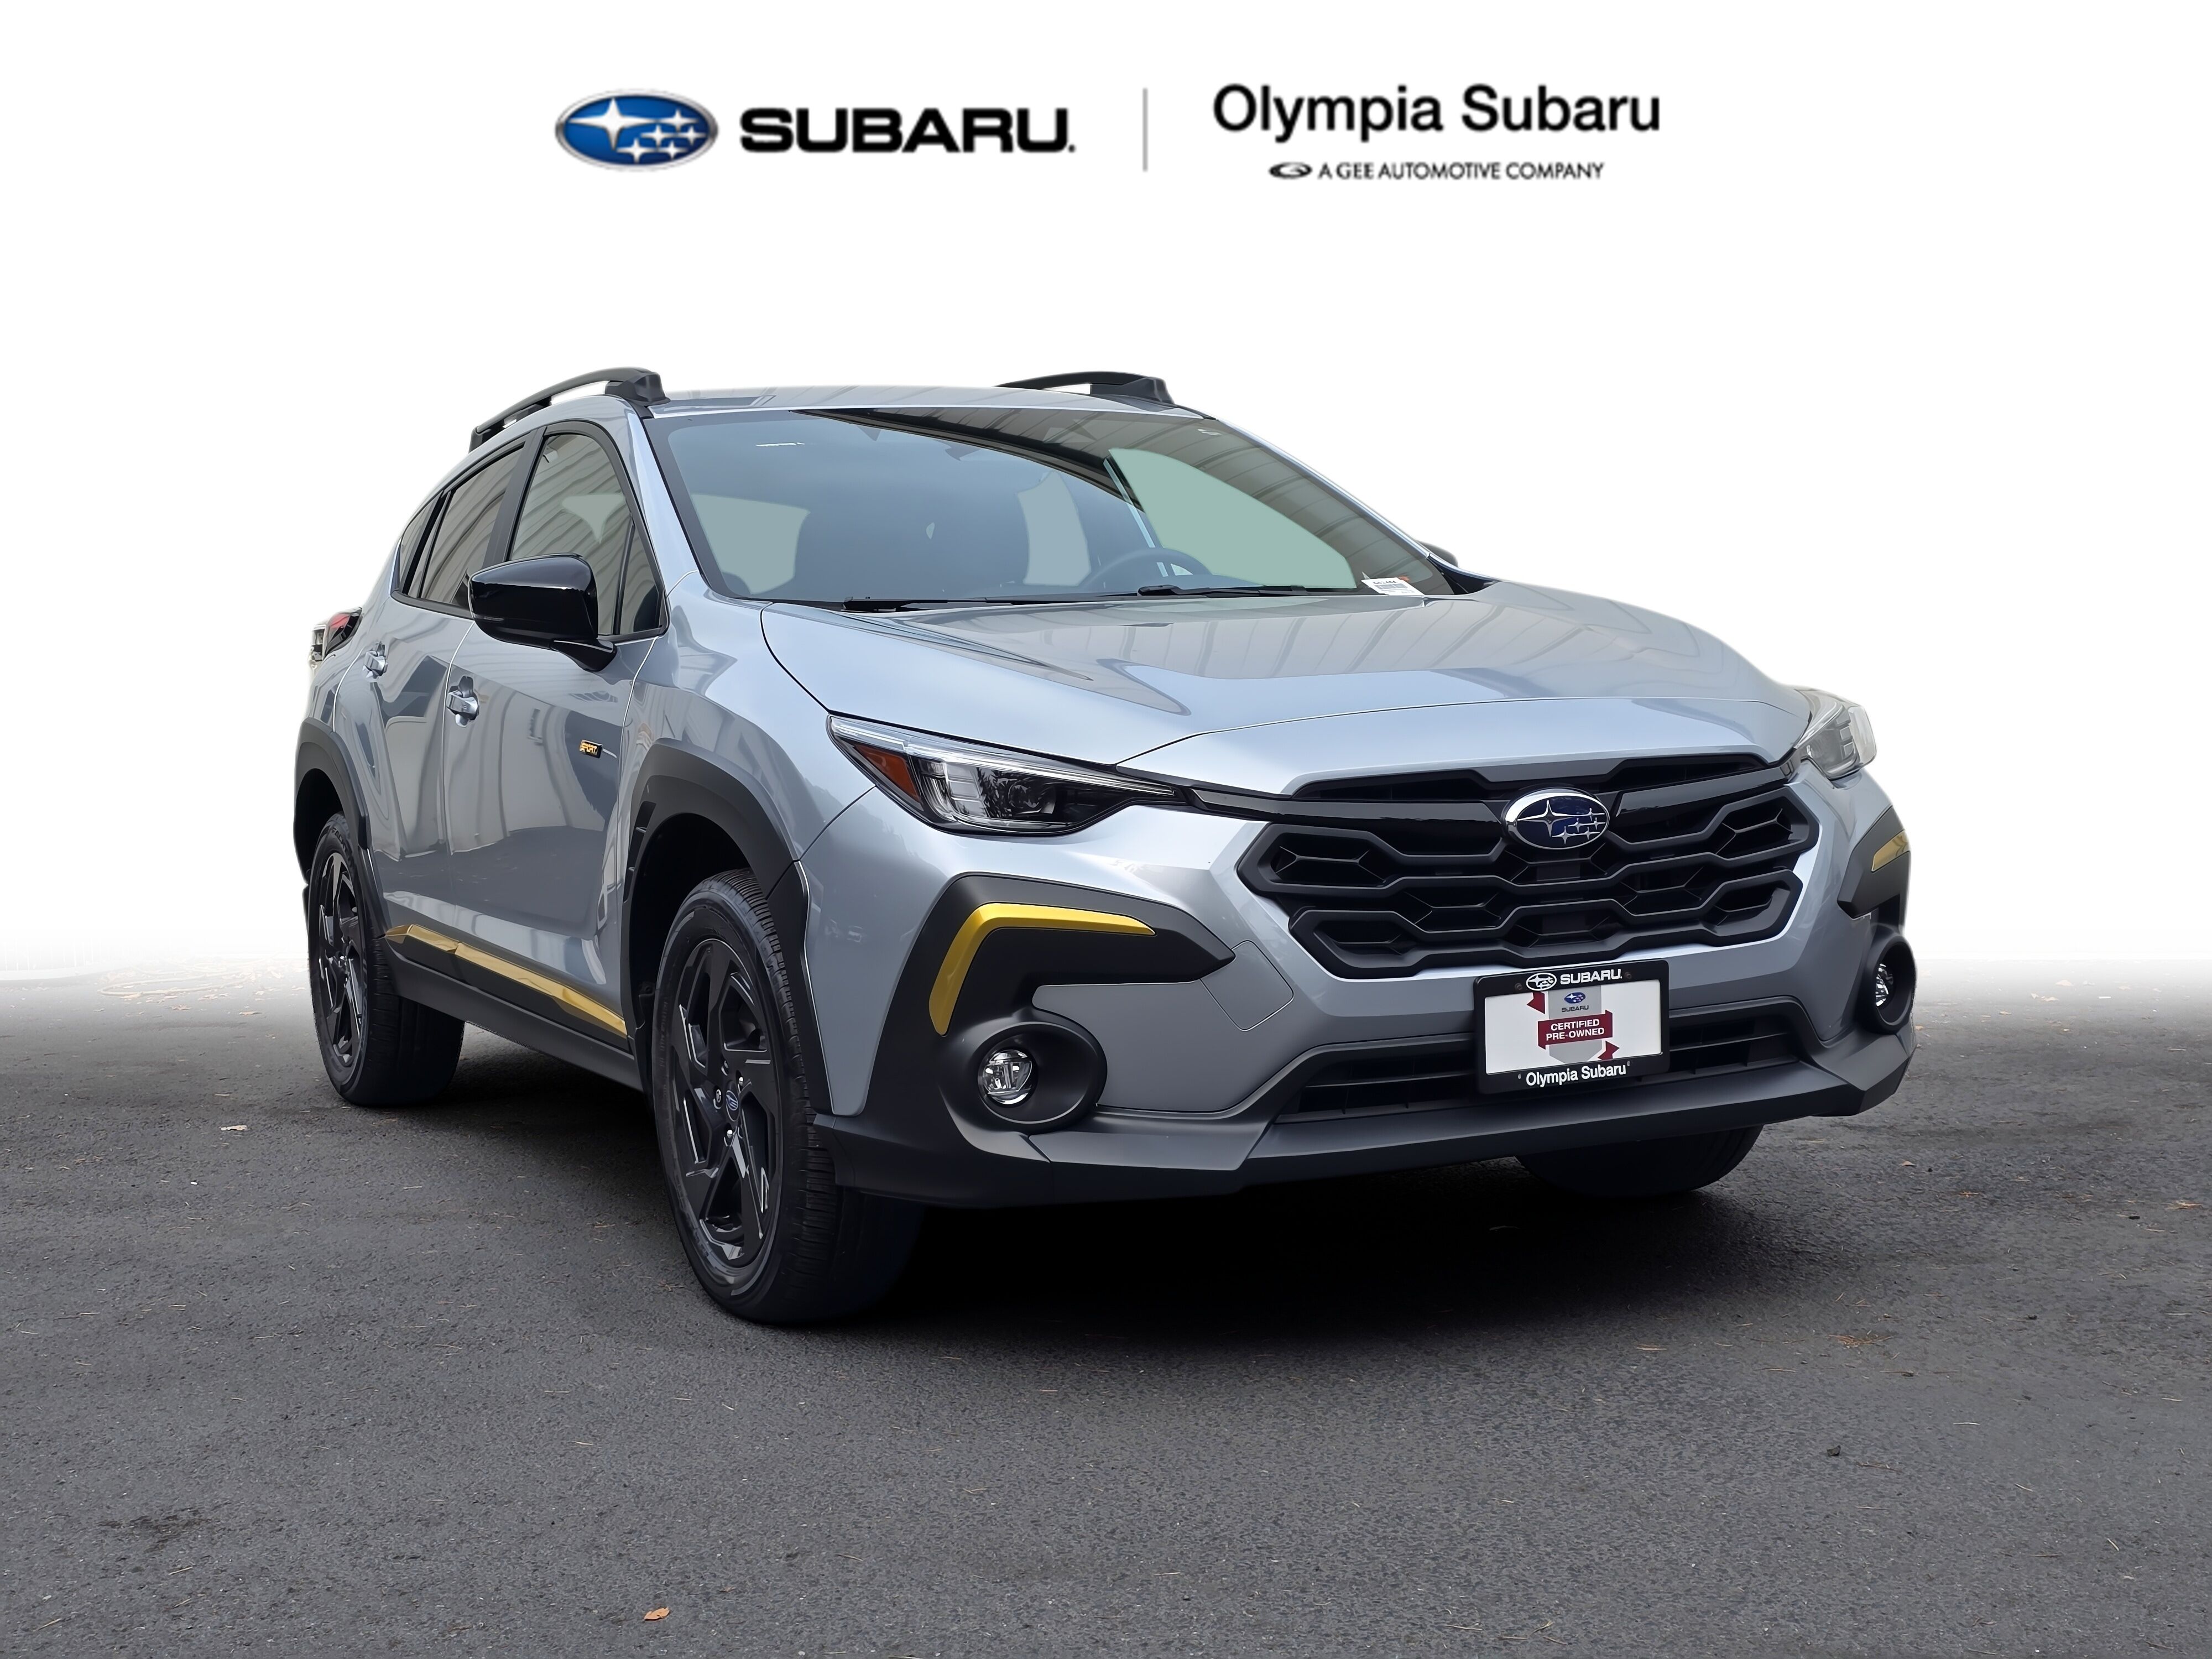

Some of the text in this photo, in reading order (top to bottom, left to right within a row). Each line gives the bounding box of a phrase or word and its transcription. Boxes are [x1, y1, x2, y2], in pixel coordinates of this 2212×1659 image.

[1561, 1004, 1589, 1013] SUBARU
[1551, 1019, 1600, 1032] CERTIFIED
[1546, 1027, 1605, 1041] PRE-OWNED
[1526, 1064, 1626, 1088] Olympia Subaru
